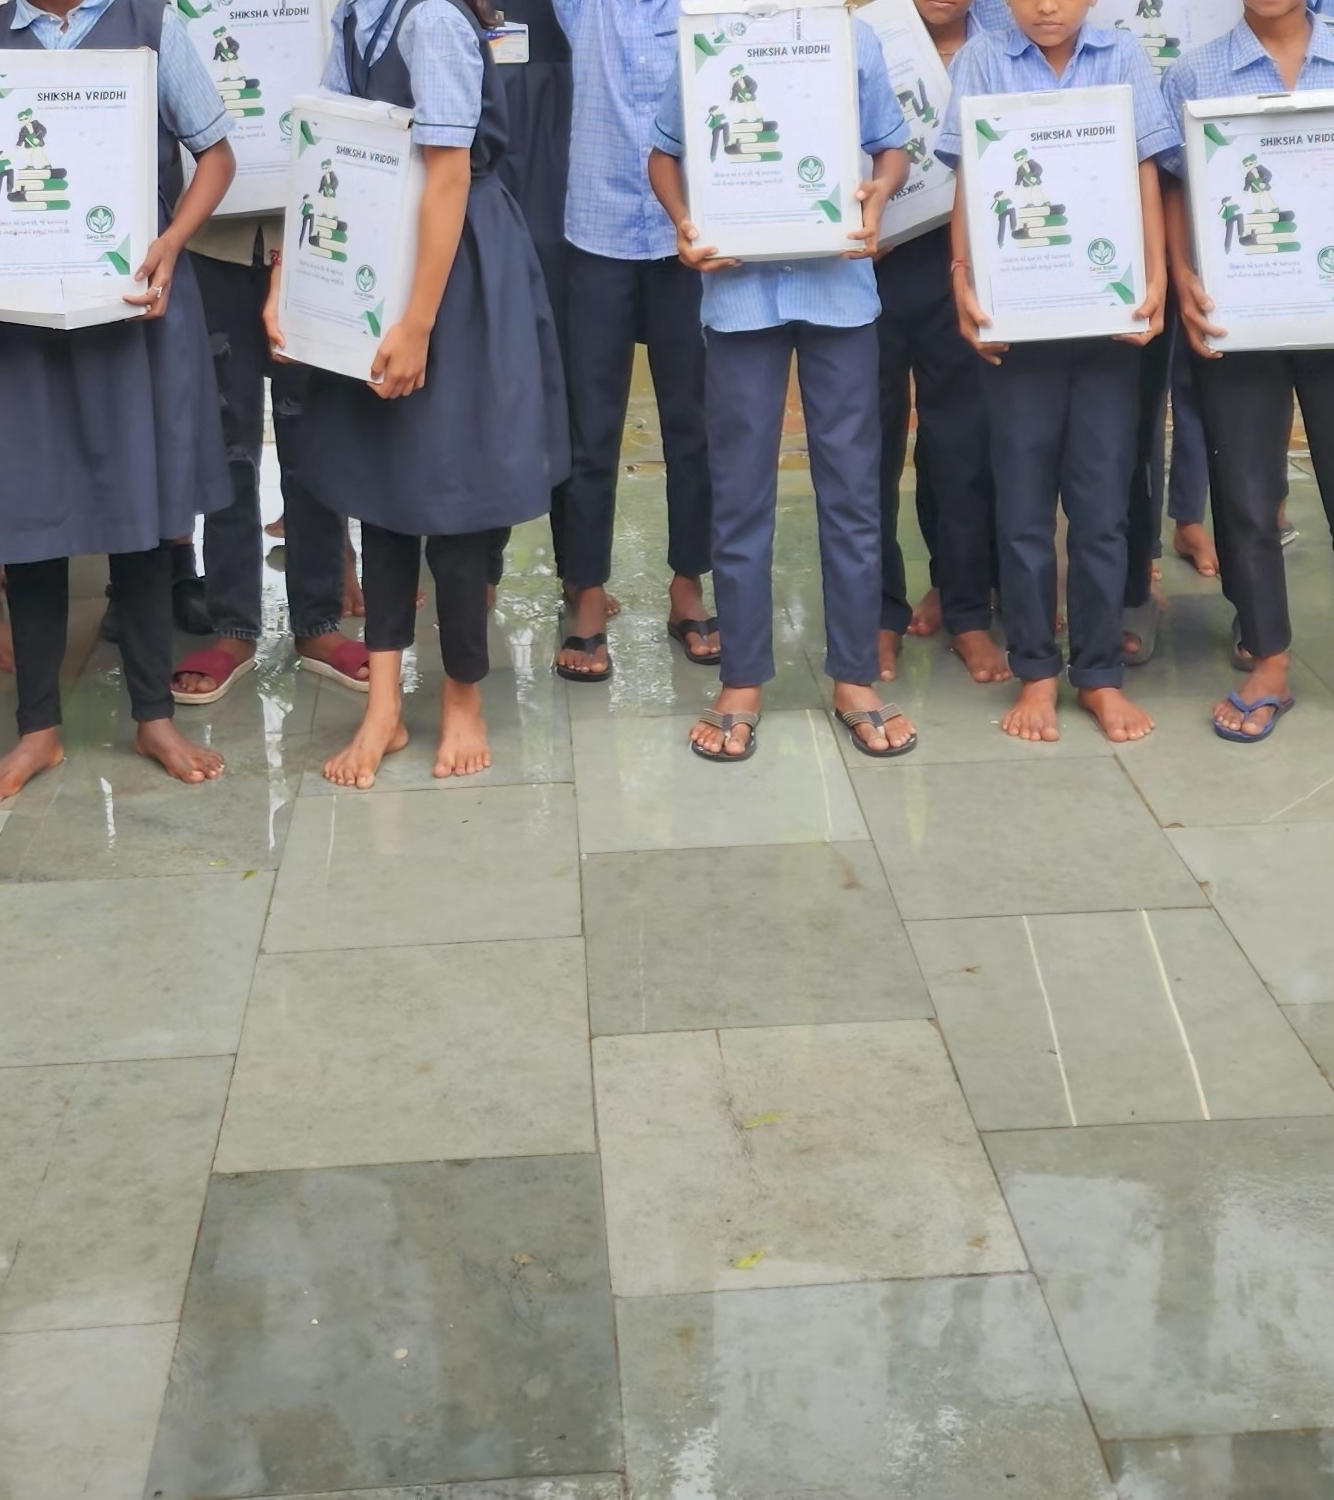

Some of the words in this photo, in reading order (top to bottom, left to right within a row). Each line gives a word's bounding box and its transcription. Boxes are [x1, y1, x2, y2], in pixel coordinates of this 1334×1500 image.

[229, 9, 269, 19] SHIKSHA
[273, 7, 309, 18] VRIDDHI
[747, 46, 787, 57] SHIKSHA
[791, 44, 830, 55] VRIDDHI
[37, 91, 82, 102] SHIKSHA
[86, 90, 126, 101] VRIDDHI
[1030, 129, 1072, 141] SHIKSHA
[1076, 125, 1115, 137] VRIDDHI
[1260, 135, 1303, 147] SHIKSHA
[335, 145, 367, 161] SHIKSHA
[370, 153, 400, 167] VRIDDHI
